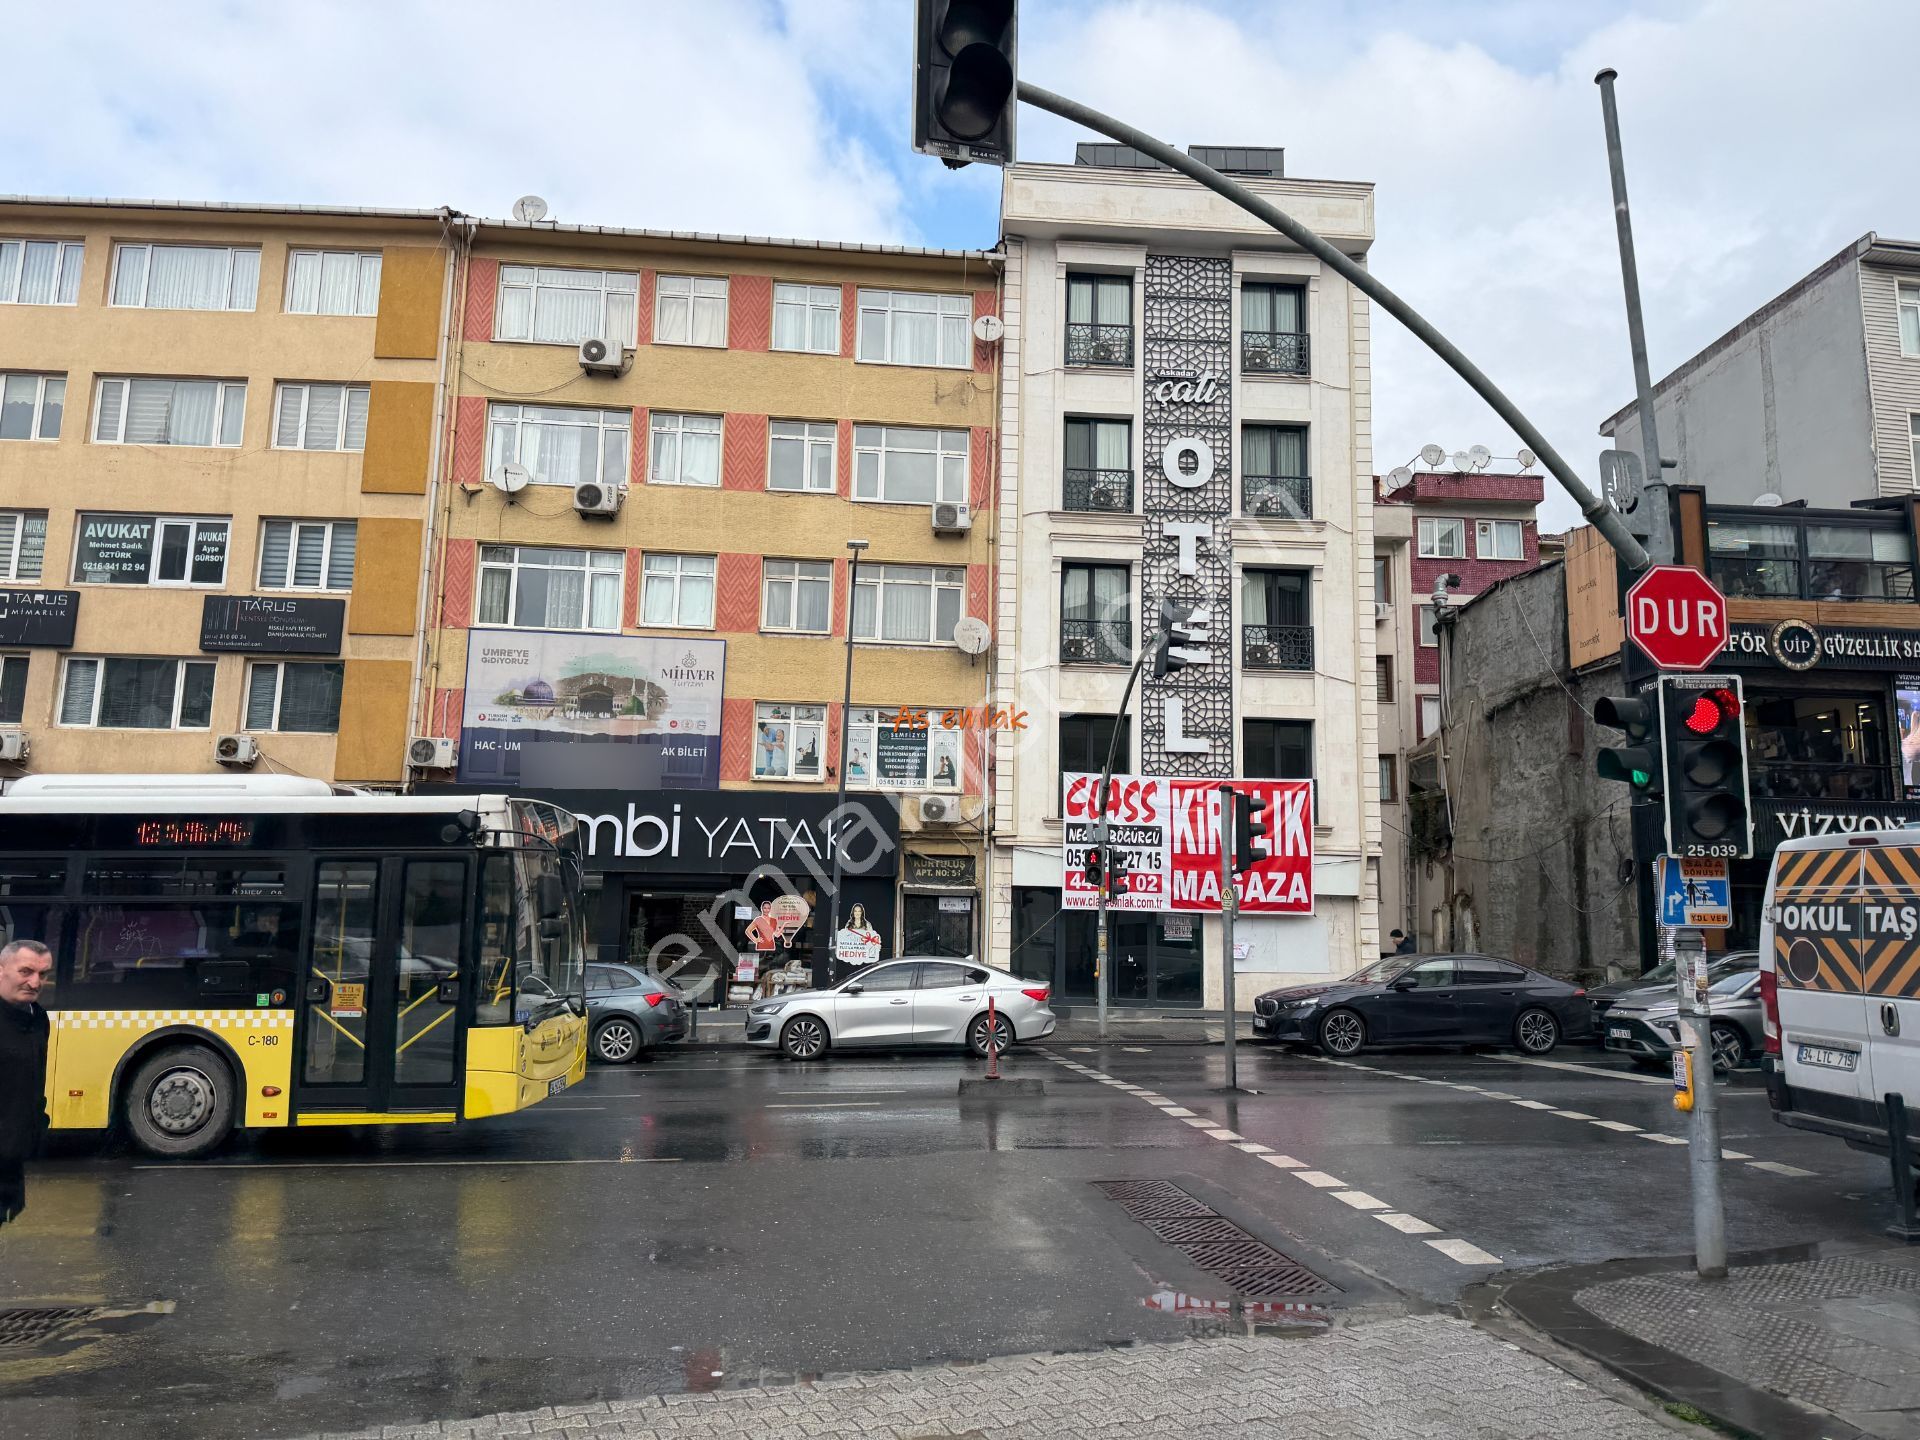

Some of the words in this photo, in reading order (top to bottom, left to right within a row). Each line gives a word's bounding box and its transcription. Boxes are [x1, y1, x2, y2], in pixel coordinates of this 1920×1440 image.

[24, 520, 48, 532] AVUKA
[84, 523, 151, 539] AVUKAT
[197, 532, 227, 542] AVUKAT
[89, 541, 120, 549] Mehmet
[121, 542, 143, 550] Sadık
[202, 545, 219, 554] Ayşe
[99, 550, 132, 559] ÖZTÜRK
[194, 554, 224, 562] GÜRSOY
[82, 562, 103, 570] 0216
[104, 562, 120, 570] 341
[121, 563, 133, 571] 82
[134, 563, 145, 571] 94
[12, 593, 69, 606] TARUS
[1162, 437, 1214, 753] OTEL
[11, 608, 66, 616] MİMARLIK
[242, 600, 297, 613] TARUS
[1638, 597, 1719, 638] DUR
[1722, 632, 1769, 655] FÖR
[1824, 634, 1902, 659] GÜZELLİK
[482, 648, 529, 658] UMRE'YE
[661, 665, 715, 681] MİHVER
[672, 680, 704, 688] Turizm
[474, 741, 496, 750] HAC
[504, 742, 520, 751] UM
[661, 747, 675, 756] AK
[677, 746, 707, 757] BİLETİ
[1172, 788, 1309, 857] KİRLIK
[577, 802, 681, 857] mbi
[694, 816, 852, 861] YATAK
[1687, 844, 1737, 857] 25-039
[913, 860, 966, 871] KURTULUŞ
[1127, 850, 1142, 869] 27
[1147, 851, 1162, 870] 15
[1685, 858, 1723, 868] SAĞA
[915, 869, 933, 877] APT.
[1135, 874, 1158, 892] 02
[1691, 914, 1708, 922] YOL
[1710, 914, 1728, 922] VER
[1783, 905, 1851, 932] OKUL
[1865, 906, 1920, 940] TAŞ
[838, 950, 867, 958] HEDİYE
[248, 1035, 279, 1047] C-180
[1802, 1048, 1813, 1061] 34
[1837, 1052, 1854, 1067] 719
